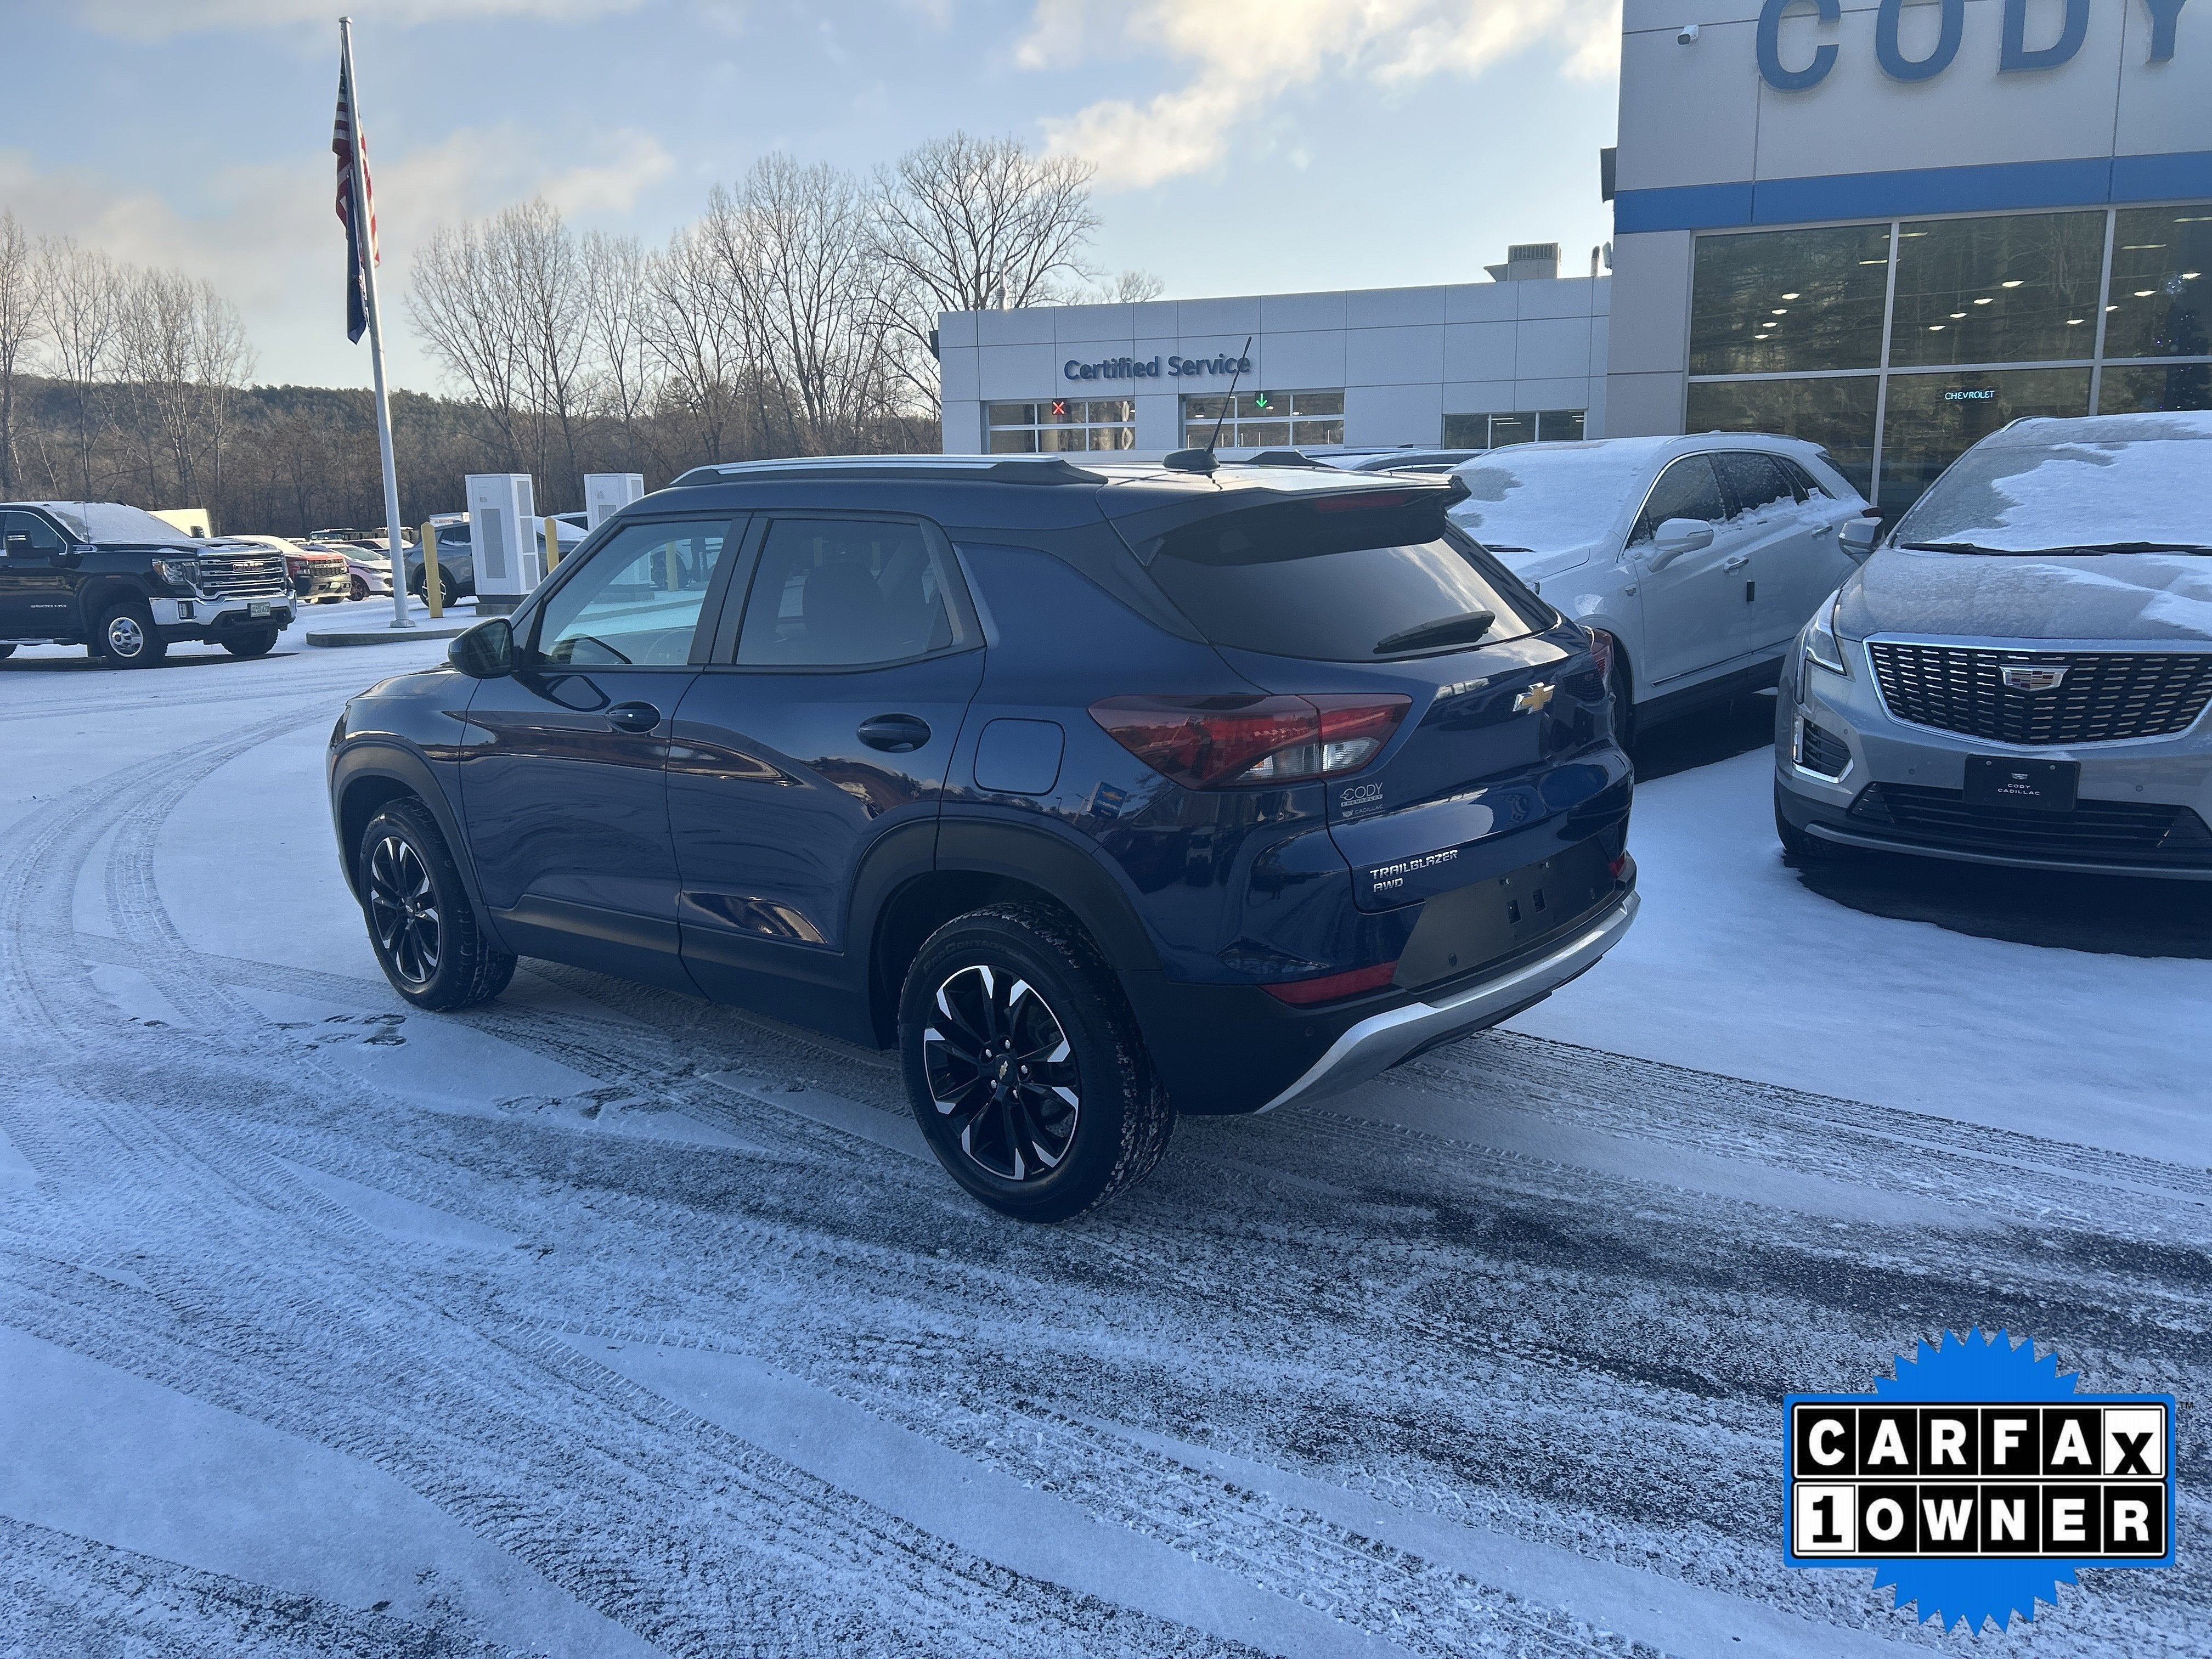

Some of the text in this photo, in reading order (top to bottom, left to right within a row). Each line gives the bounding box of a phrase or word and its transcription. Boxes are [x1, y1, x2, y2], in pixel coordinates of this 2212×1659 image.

[1757, 0, 2186, 90] CODY
[1064, 353, 1251, 380] Certified Service
[1945, 390, 1995, 400] CHEVROLET
[1340, 782, 1383, 800] CODY
[1342, 795, 1382, 806] CHEVROLET
[1355, 804, 1383, 814] CADILLAC
[1370, 850, 1458, 879] TRAILBLAZER
[1373, 878, 1403, 892] AWD
